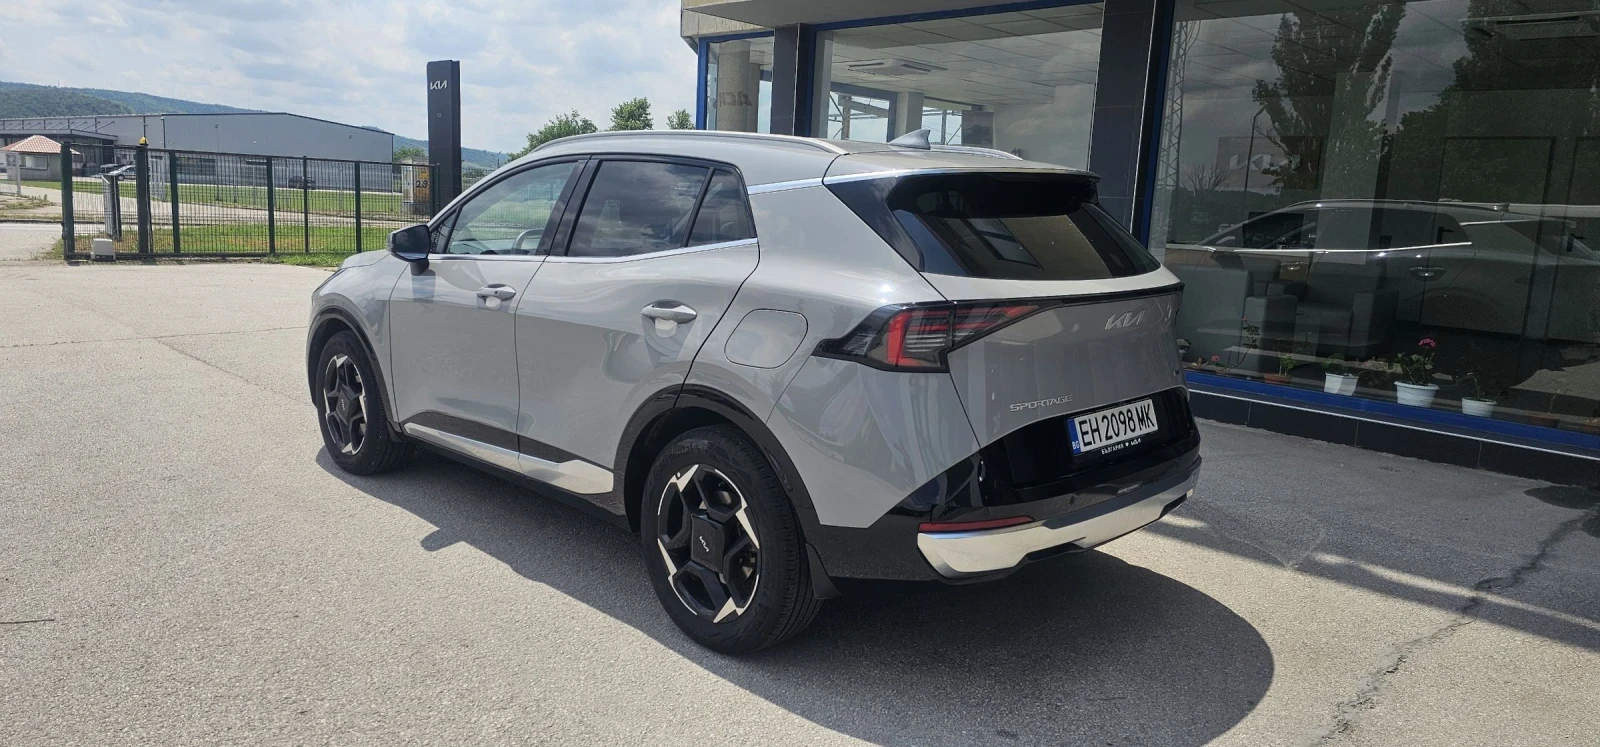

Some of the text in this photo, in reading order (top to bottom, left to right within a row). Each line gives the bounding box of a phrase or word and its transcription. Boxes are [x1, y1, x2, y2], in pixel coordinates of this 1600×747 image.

[429, 80, 448, 90] KIA
[1104, 309, 1147, 331] KIA
[1009, 394, 1073, 412] SPORTAGE
[1072, 440, 1080, 451] BG
